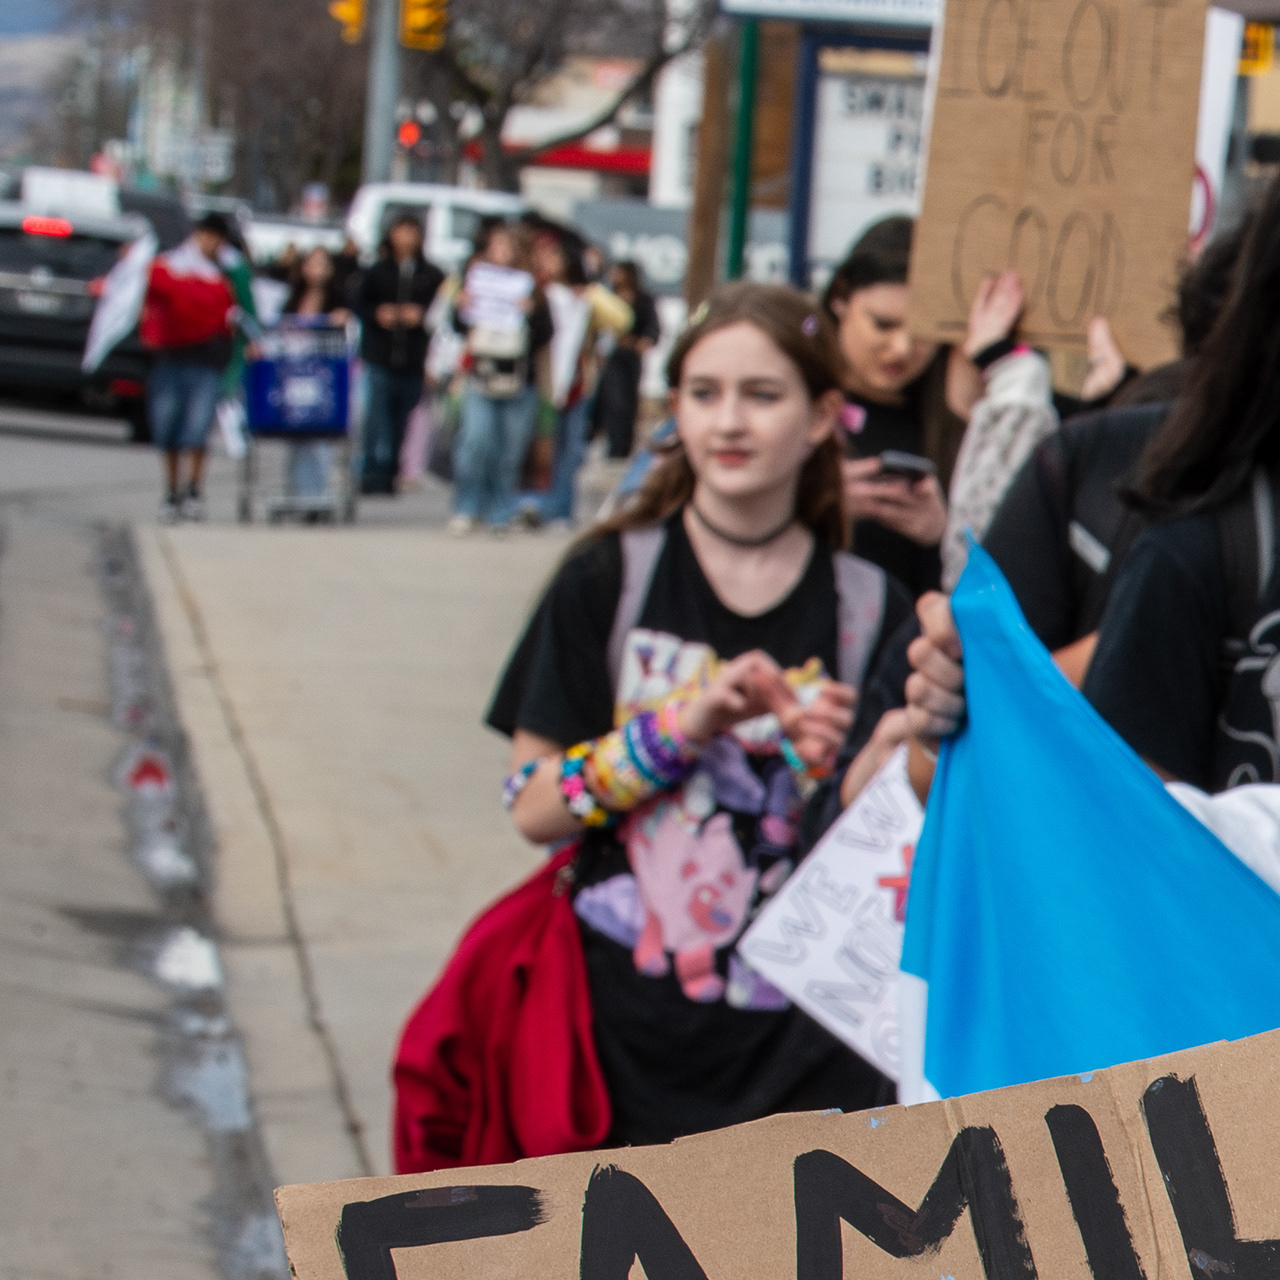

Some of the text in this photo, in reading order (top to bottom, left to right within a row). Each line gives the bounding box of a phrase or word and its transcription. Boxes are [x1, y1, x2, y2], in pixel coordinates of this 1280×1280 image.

[938, 0, 1176, 112] ICE OUT
[1018, 110, 1119, 187] FOR
[951, 193, 1127, 329] GOOD
